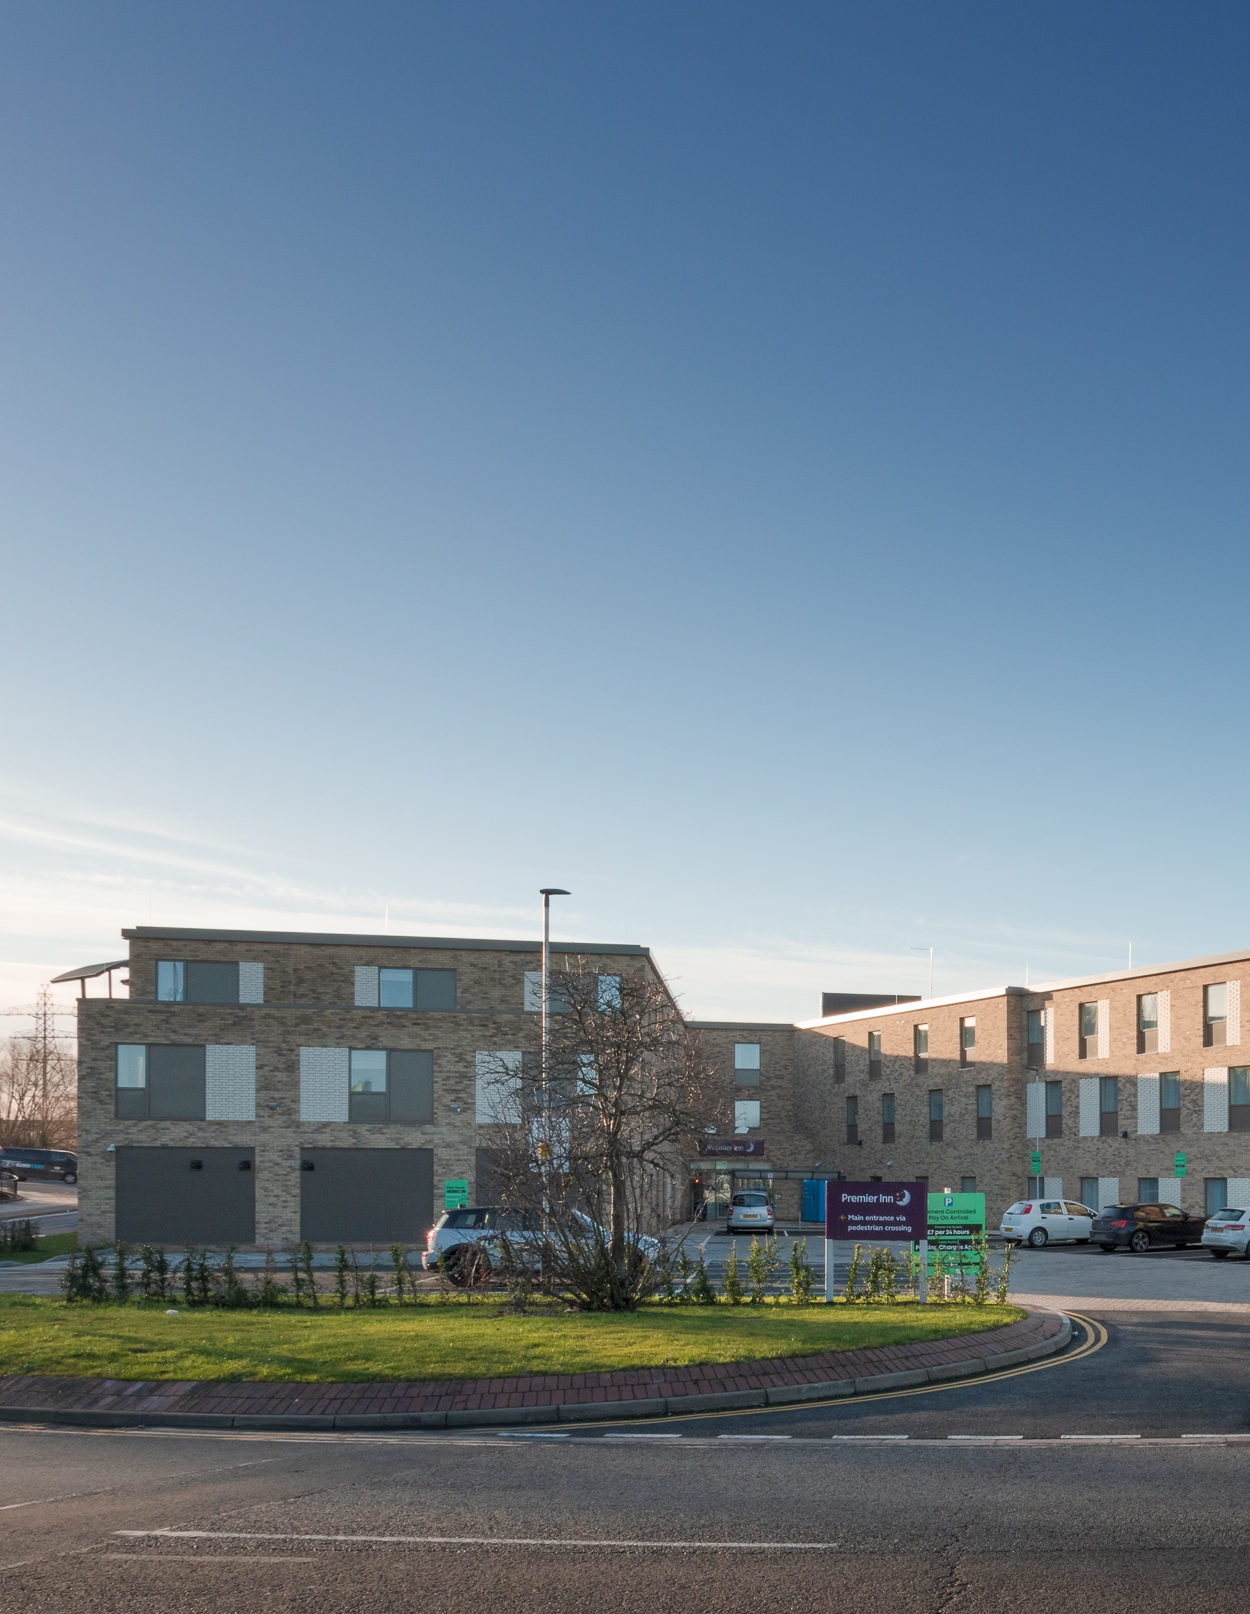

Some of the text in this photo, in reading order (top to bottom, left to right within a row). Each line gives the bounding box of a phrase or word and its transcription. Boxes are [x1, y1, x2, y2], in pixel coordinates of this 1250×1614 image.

[841, 1193, 894, 1203] Premier Inn
[847, 1224, 912, 1233] pedestrian crossing
